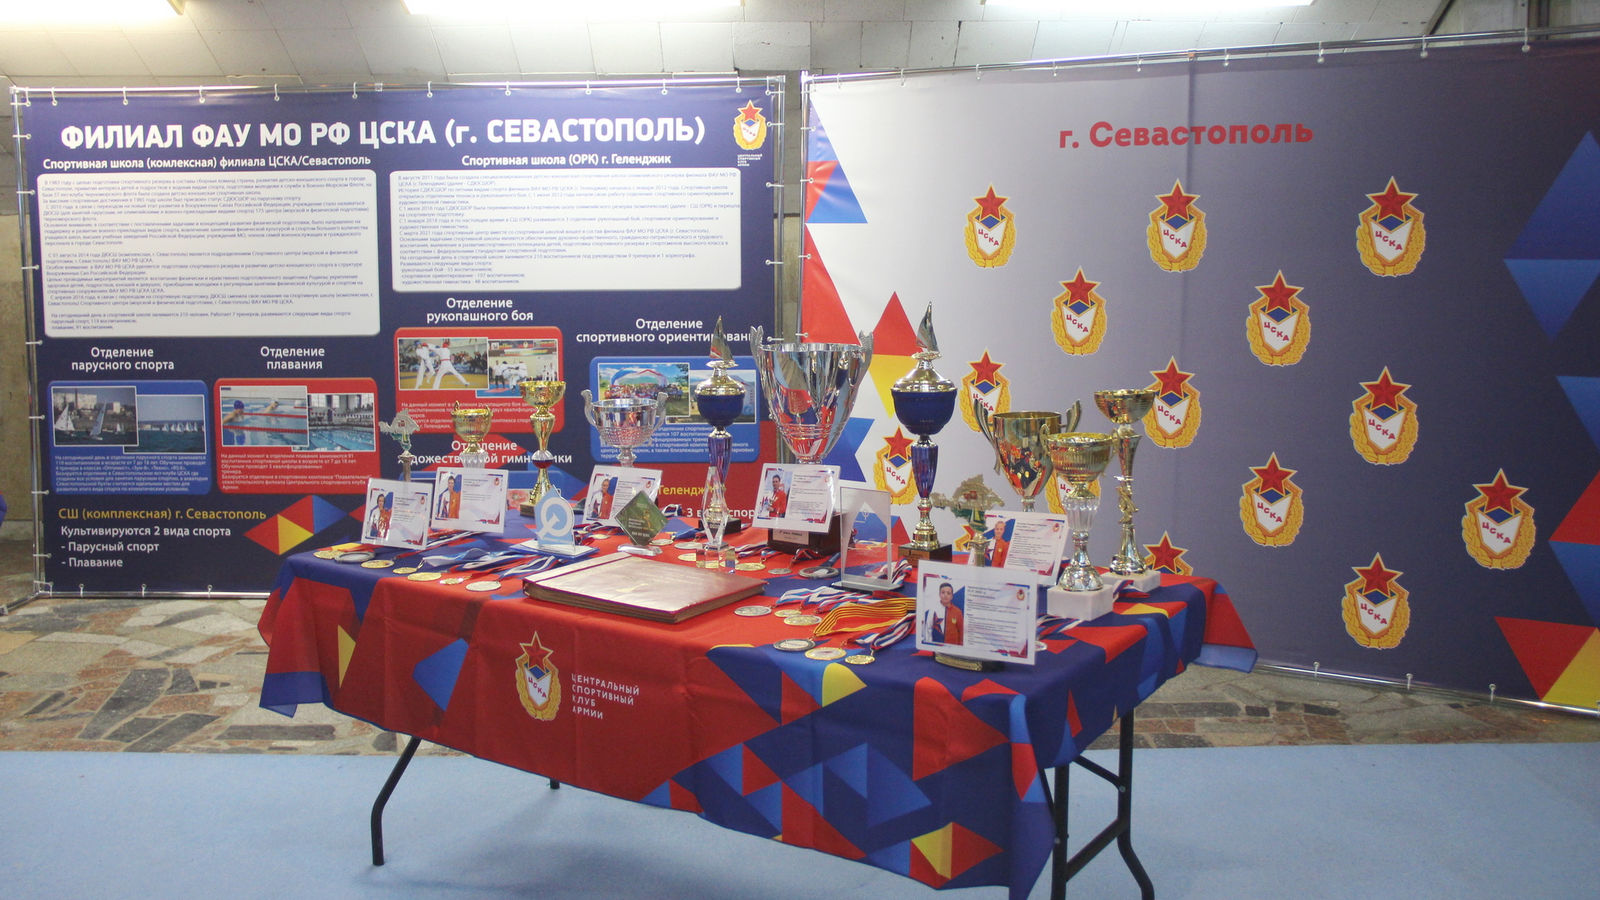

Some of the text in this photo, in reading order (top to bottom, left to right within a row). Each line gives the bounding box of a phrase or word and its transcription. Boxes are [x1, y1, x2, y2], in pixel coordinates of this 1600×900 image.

[61, 116, 705, 149] ФИЛИАЛ ФАУ МО РФ ЦСКА (г. СЕВАСТОПОЛЬ)
[1059, 121, 1314, 148] г. Севастополь
[43, 155, 370, 170] Спортивная школа (комлексная) филиала ЦСКА/Севастополь
[462, 154, 671, 168] Спортивная школа (ОРК) г. Геленджик
[978, 229, 999, 246] ЦСКА
[1163, 230, 1187, 248] ЦСКА
[1375, 231, 1402, 250] ЦСКА
[446, 298, 512, 310] Отделение
[427, 309, 534, 324] рукопашного боя
[636, 318, 703, 330] Отделение
[1066, 314, 1089, 332] ЦСКА
[576, 332, 658, 343] спортивного
[1264, 322, 1290, 341] ЦСКА
[91, 347, 154, 358] Отделение
[260, 346, 325, 358] Отделение
[72, 360, 174, 371] парусного спорта
[266, 360, 323, 370] плавания
[1158, 406, 1181, 424] ЦСКА
[1366, 419, 1396, 440] ЦСКА
[887, 467, 906, 485] ЦСКА
[58, 508, 266, 520] СШ (комплексная) г. Севастополь
[687, 508, 693, 517] 3
[1255, 502, 1282, 522] ЦСКА
[61, 526, 231, 538] Культивируются 2 вида спорта
[1482, 522, 1510, 543] ЦСКА
[68, 541, 124, 554] Парусный
[127, 543, 160, 554] спорт
[69, 557, 123, 568] Плавание
[1361, 604, 1388, 624] ЦСКА
[528, 677, 546, 698] ЦСКА
[572, 673, 640, 695] ЦЕНТРАЛЬНЫЙ
[572, 684, 634, 705] СПОРТИВНЫЙ
[572, 706, 603, 719] АРМИИ
